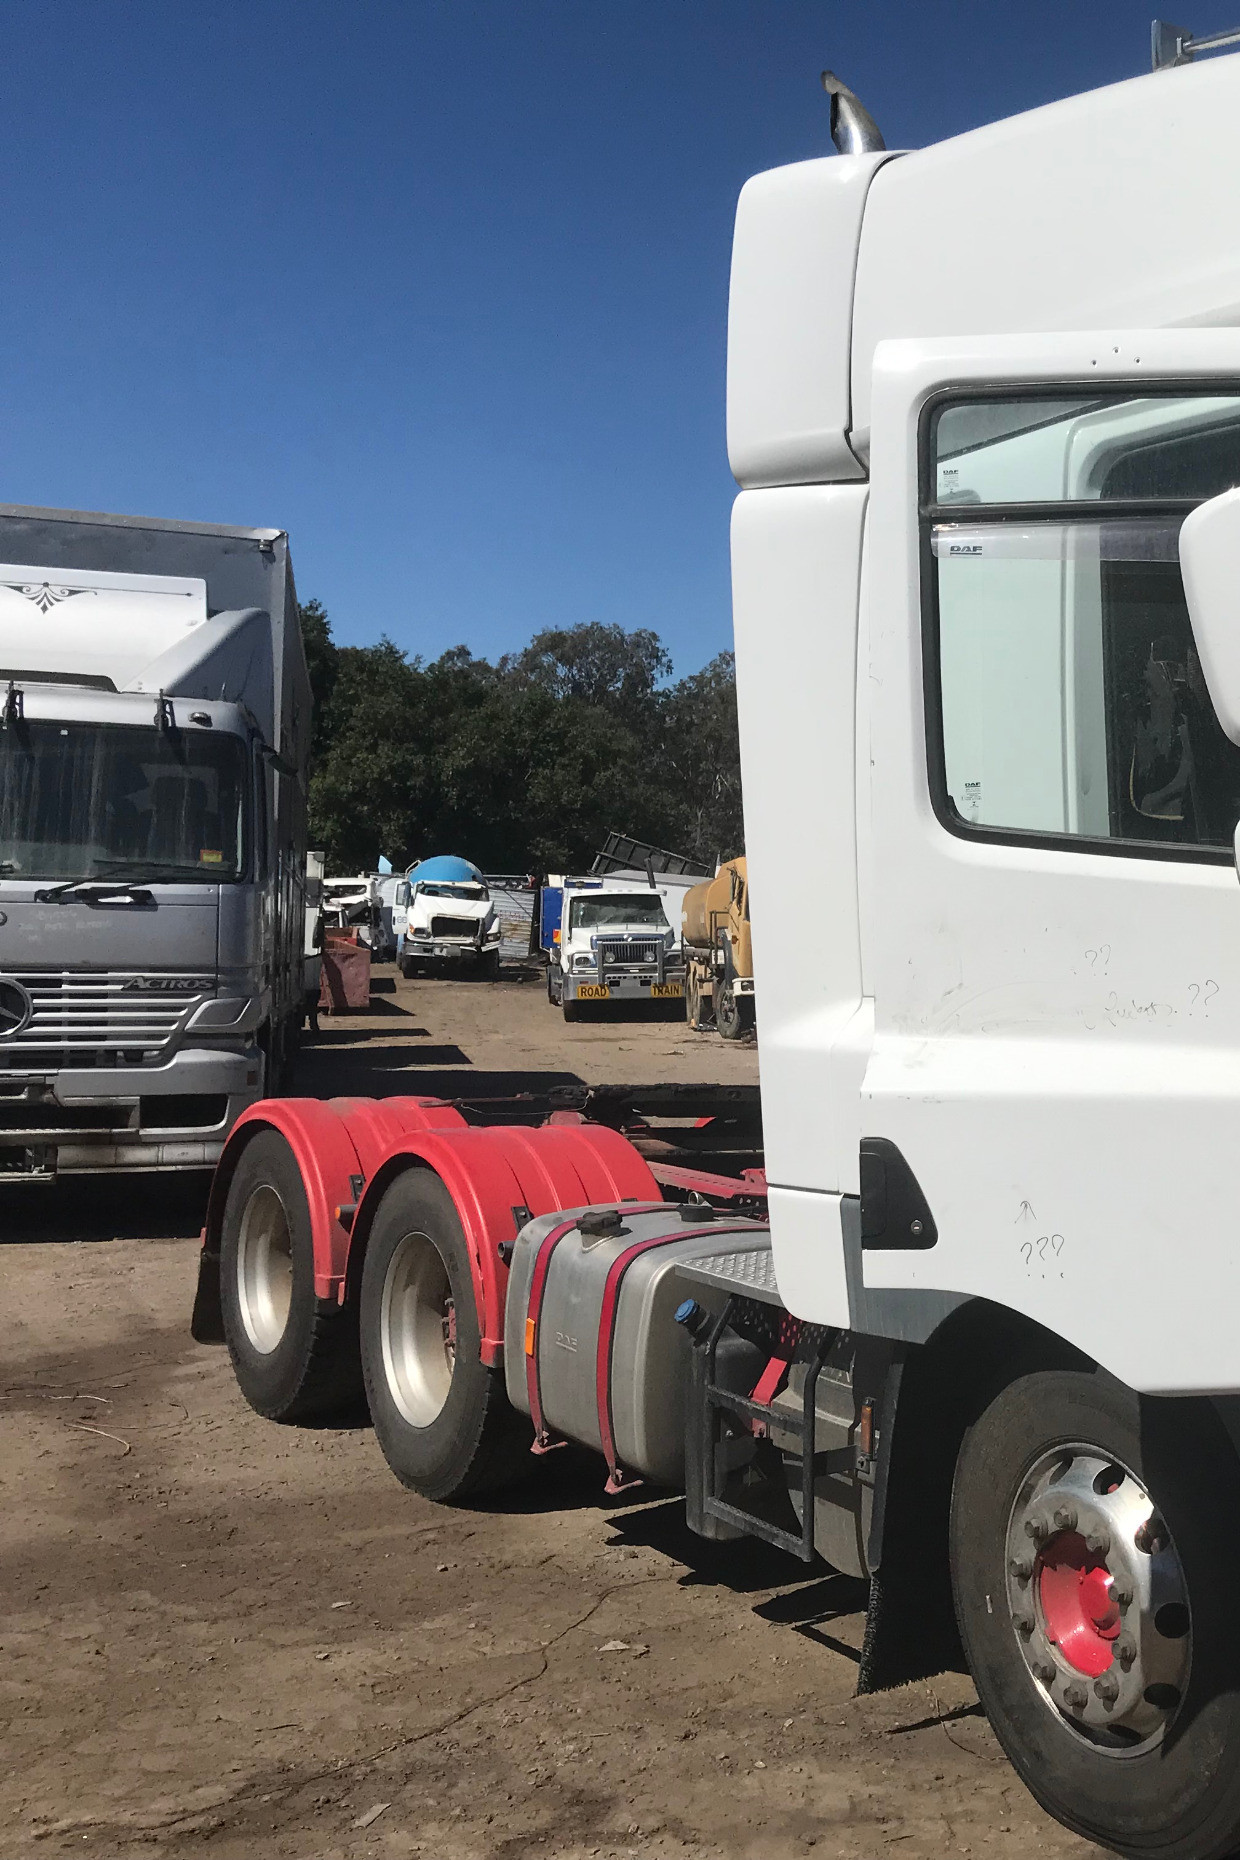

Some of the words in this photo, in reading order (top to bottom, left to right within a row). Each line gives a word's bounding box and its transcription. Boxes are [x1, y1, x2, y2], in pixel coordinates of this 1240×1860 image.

[950, 545, 983, 553] DAF
[580, 986, 607, 997] ROAD
[652, 985, 680, 996] TRAIN
